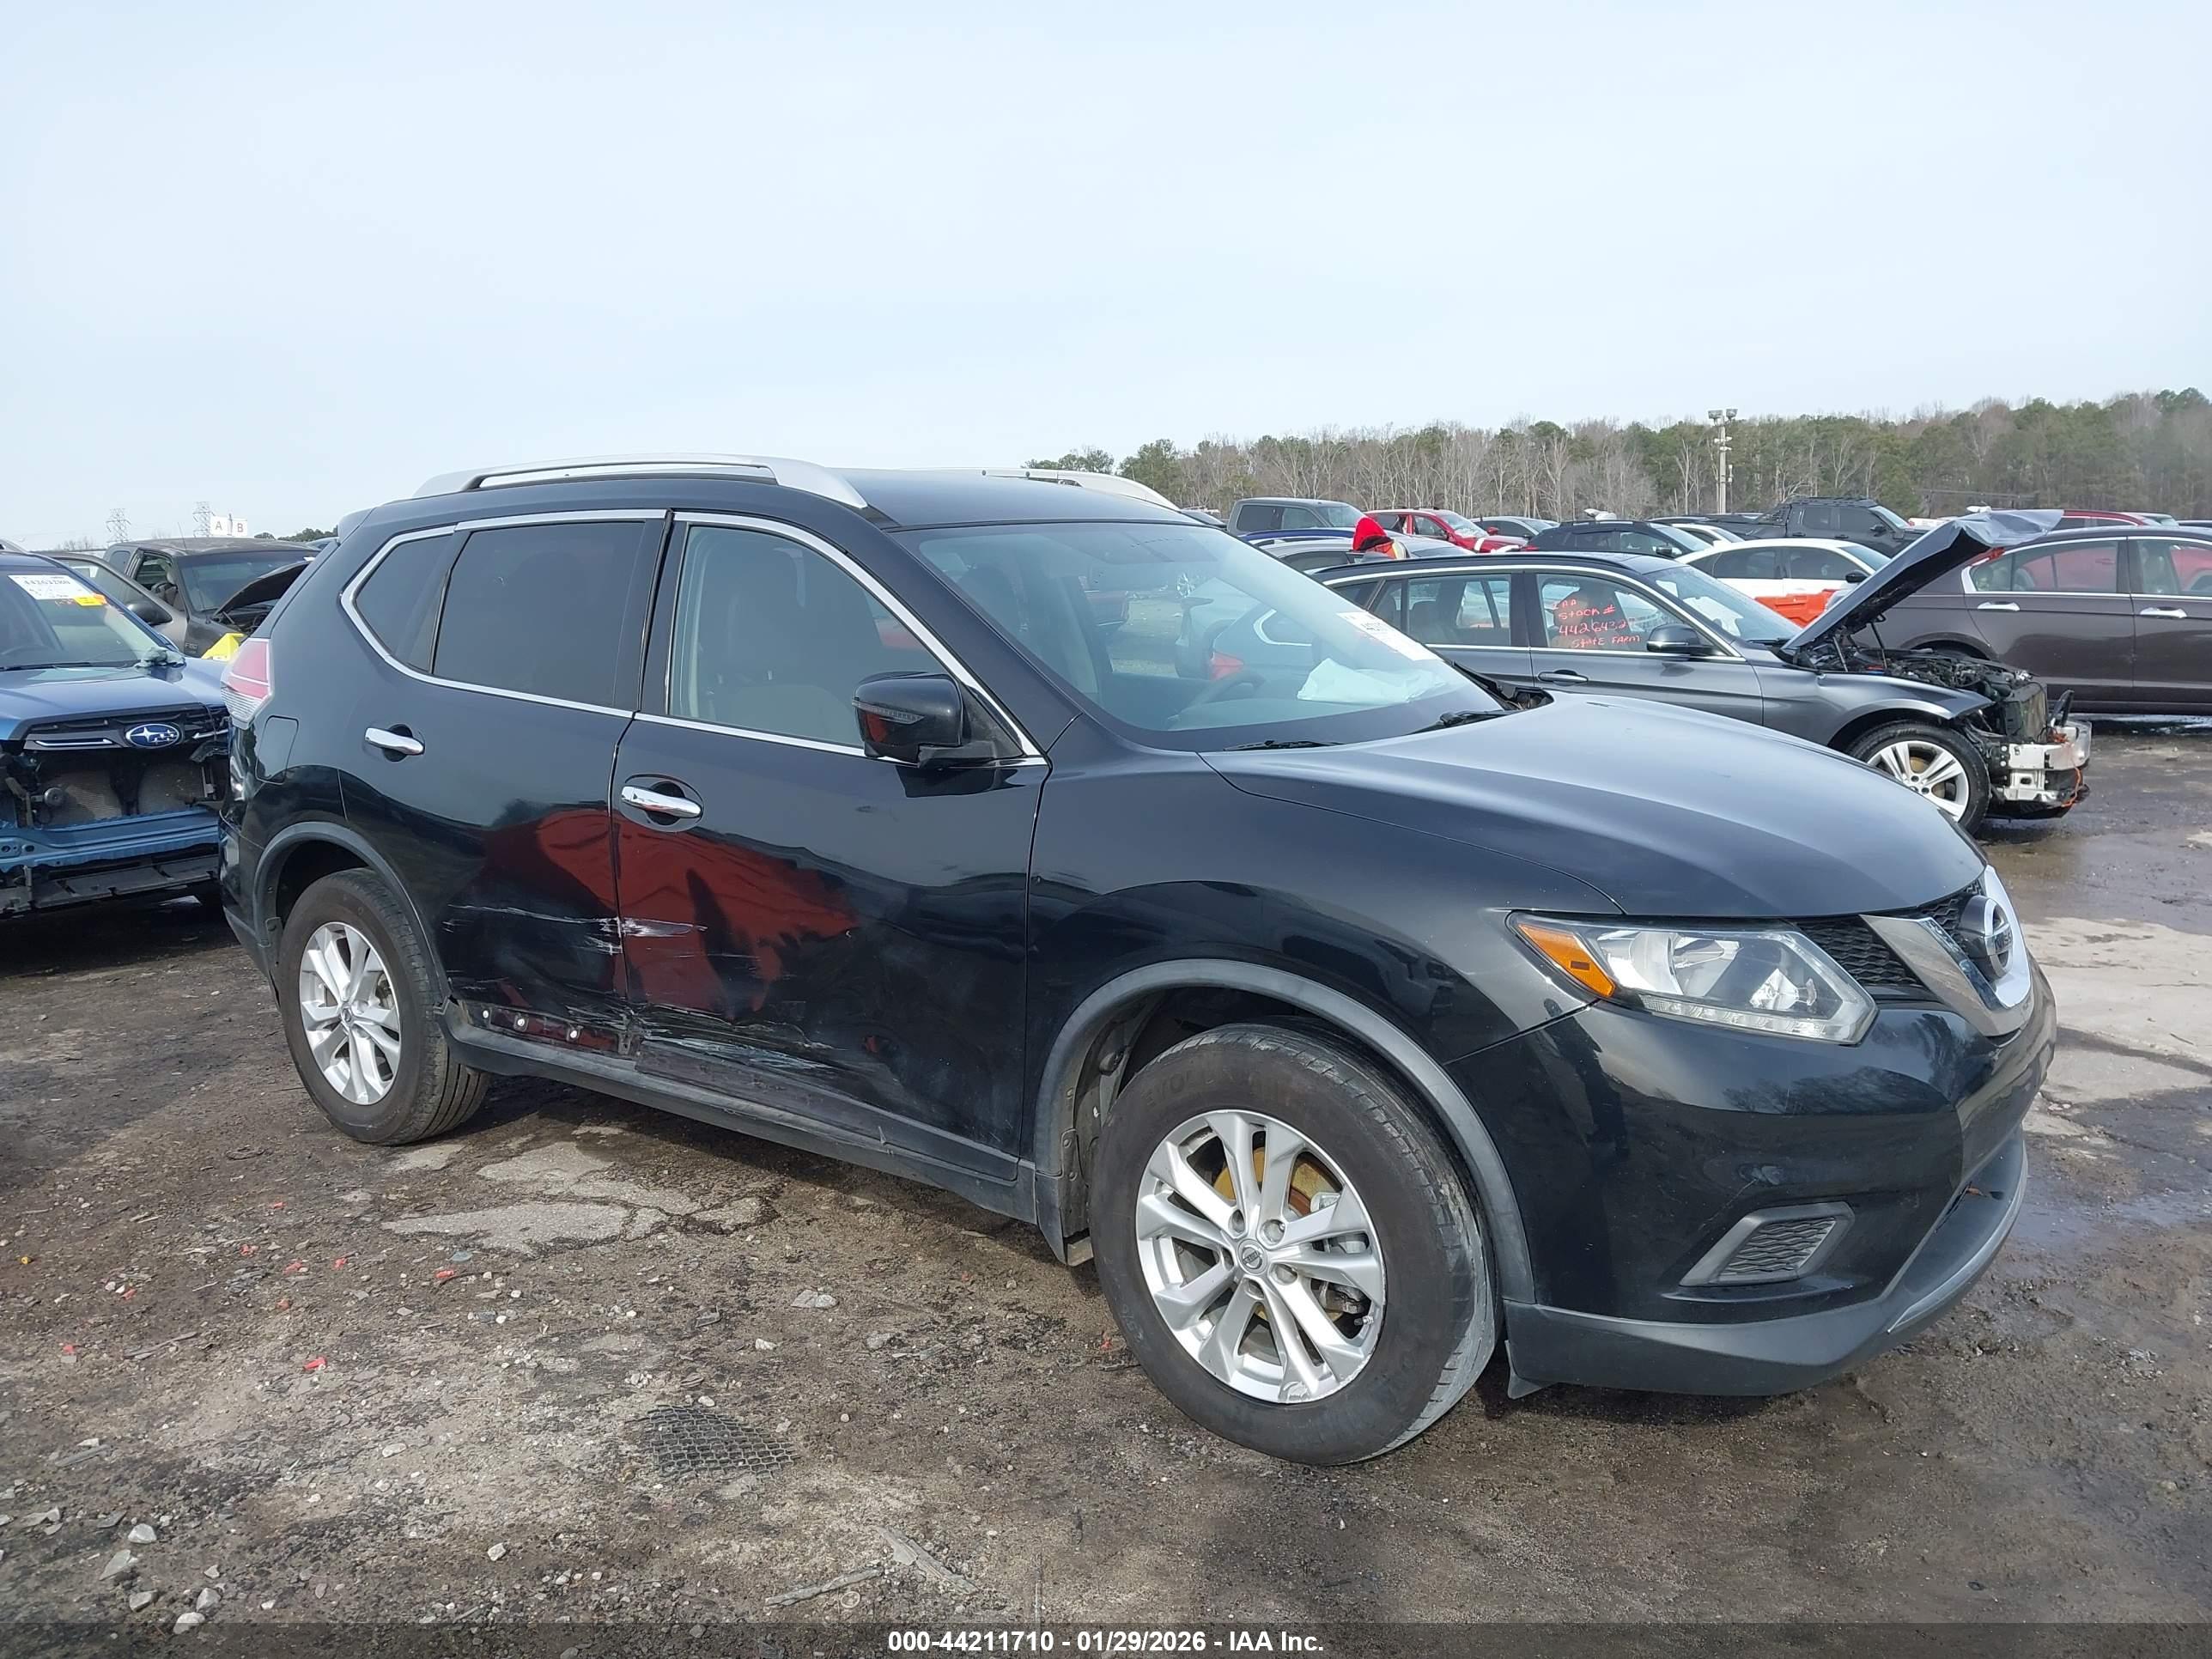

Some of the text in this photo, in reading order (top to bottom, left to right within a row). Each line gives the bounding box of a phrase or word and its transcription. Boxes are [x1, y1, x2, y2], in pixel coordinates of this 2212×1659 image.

[215, 520, 222, 531] A
[237, 522, 244, 532] B
[1603, 605, 1615, 614] #
